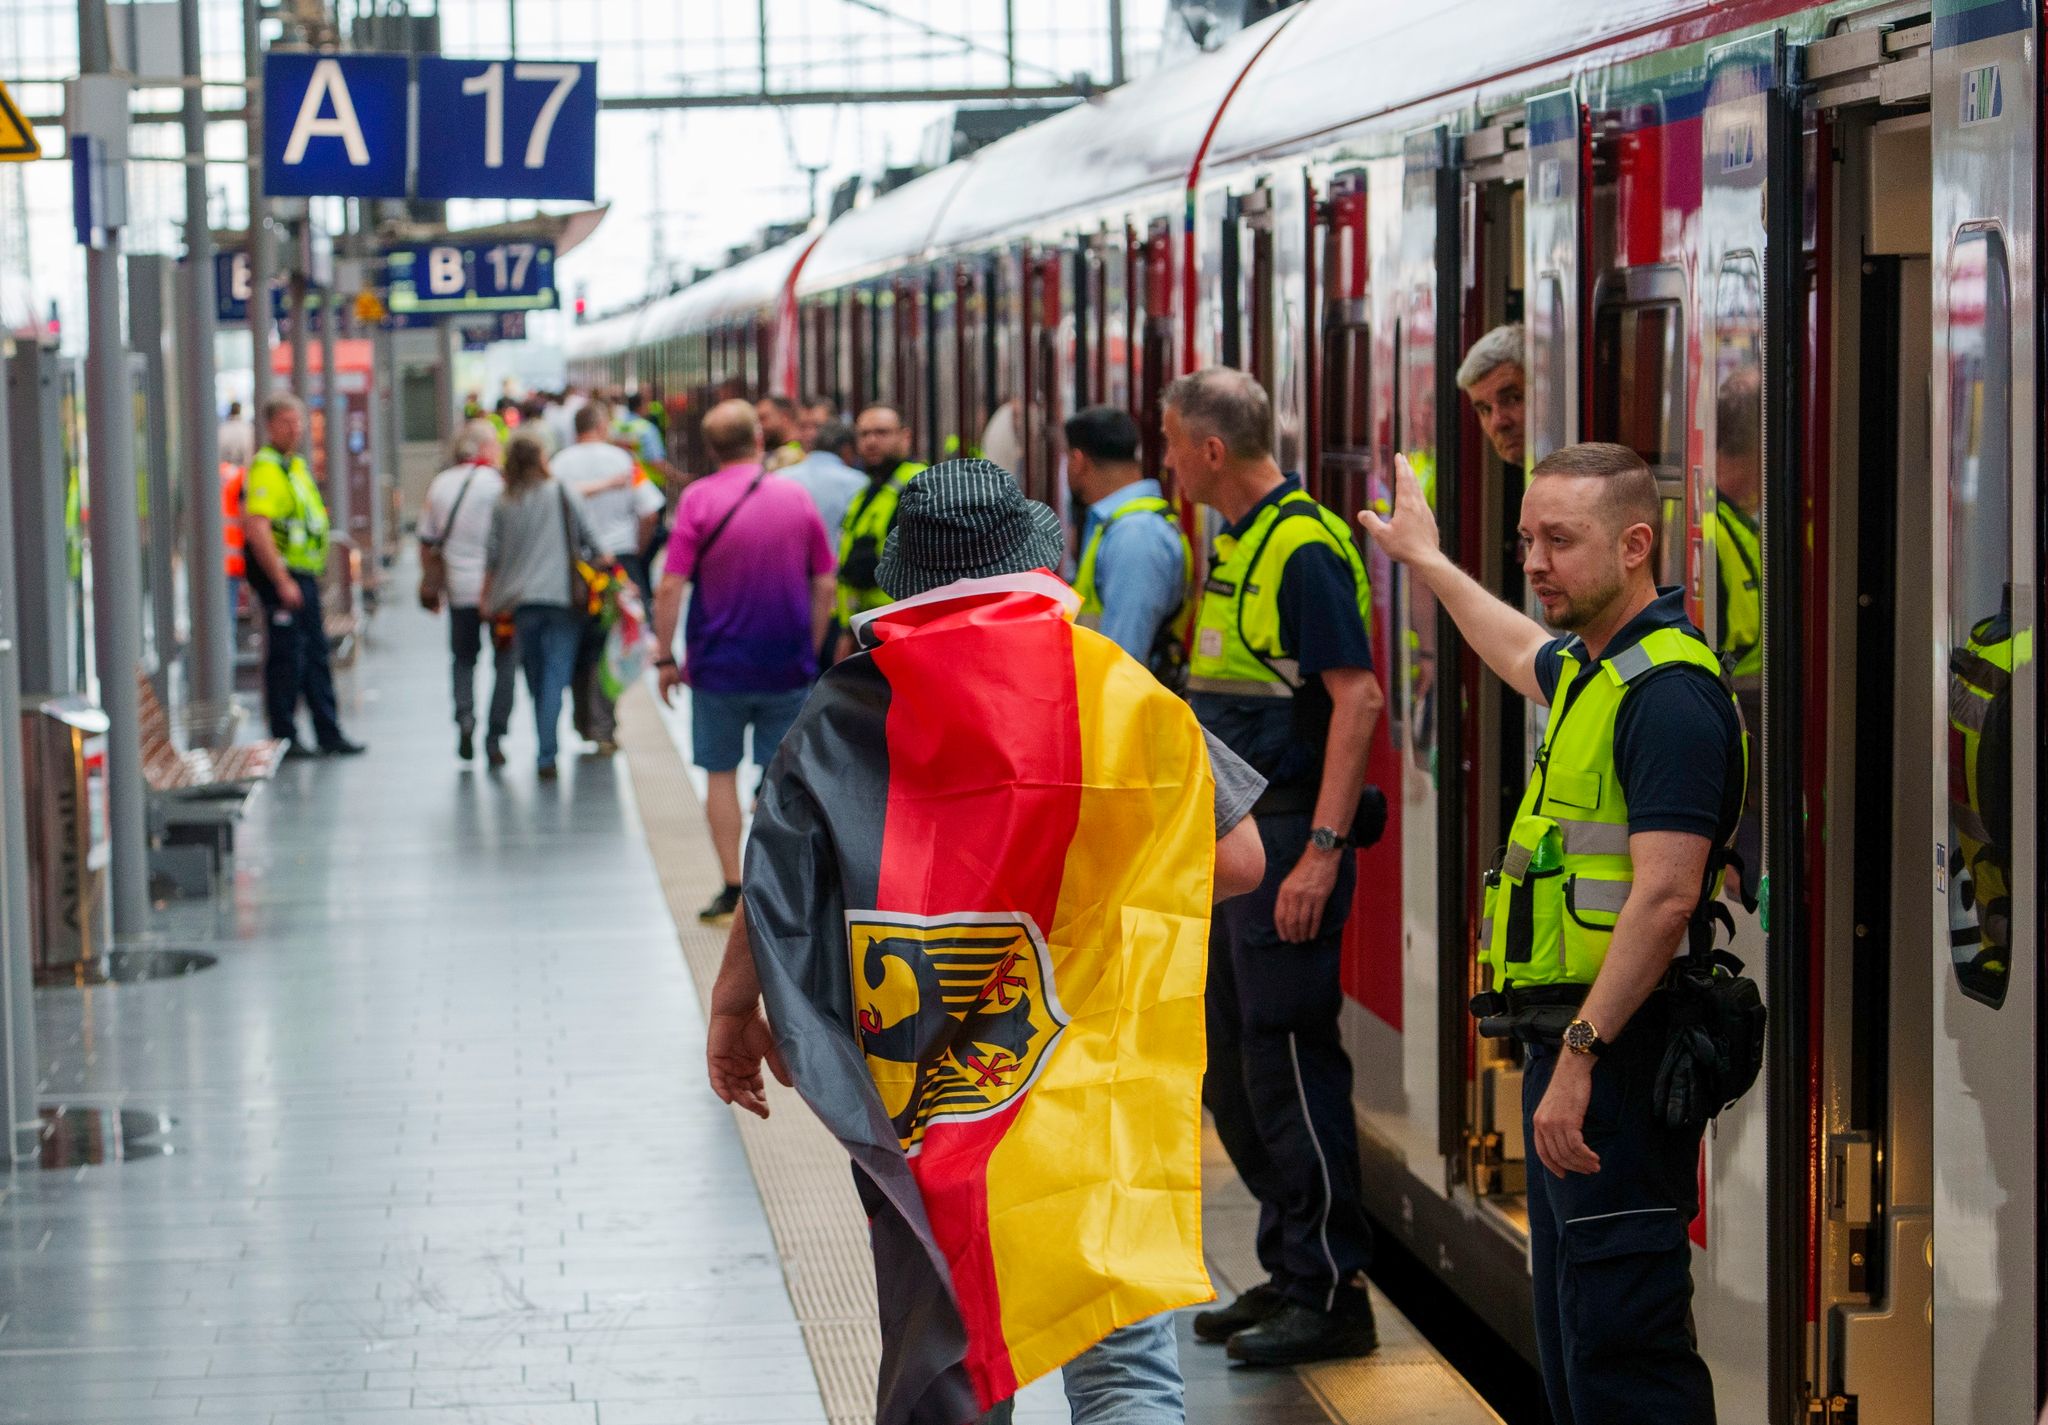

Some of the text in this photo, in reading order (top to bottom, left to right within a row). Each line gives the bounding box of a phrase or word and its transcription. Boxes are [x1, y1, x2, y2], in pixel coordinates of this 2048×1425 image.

[283, 58, 581, 168] A 17
[428, 243, 535, 295] B 17
